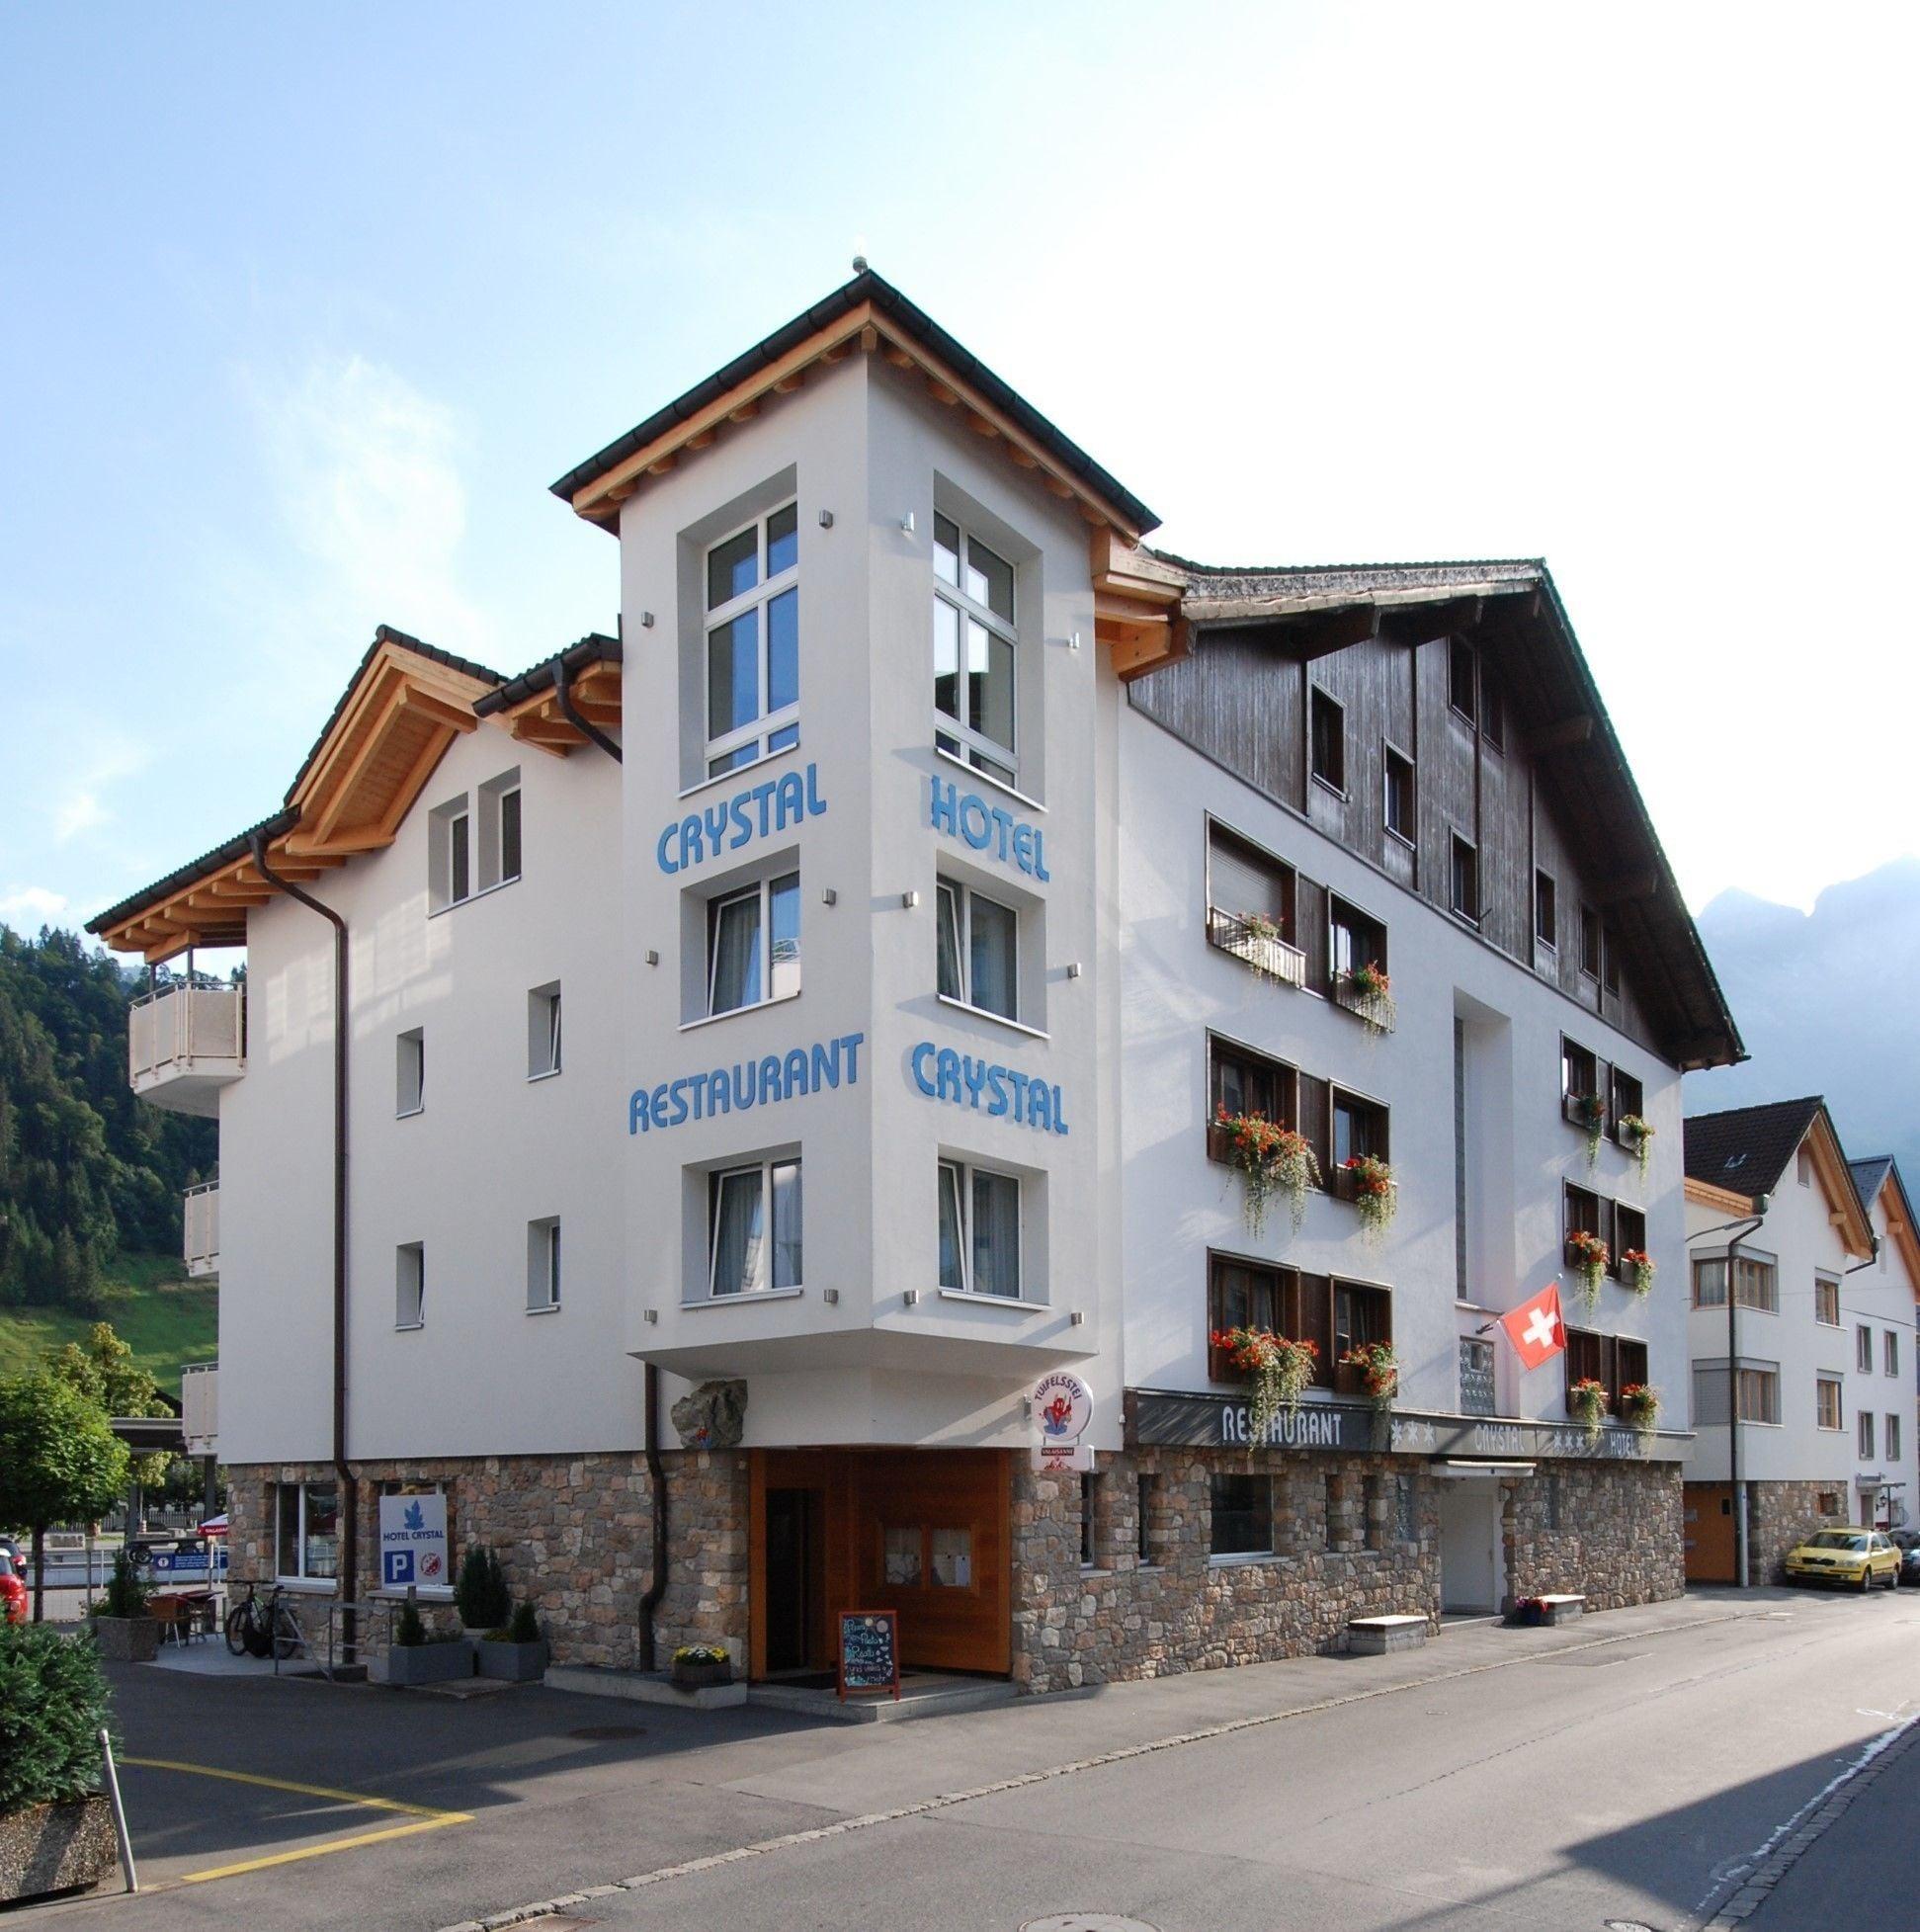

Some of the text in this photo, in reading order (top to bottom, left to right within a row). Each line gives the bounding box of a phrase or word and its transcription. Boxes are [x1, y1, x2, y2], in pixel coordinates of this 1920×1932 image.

[656, 763, 827, 875] CRYSTAL
[931, 775, 1049, 882] HOTEL
[628, 1033, 865, 1134] RESTAURANT
[911, 1042, 1069, 1134] CRYSTAL
[1034, 1375, 1083, 1401] TUIFELSSTEI
[383, 1530, 444, 1542] HOTEL CRYSTAL
[391, 1554, 408, 1580] P
